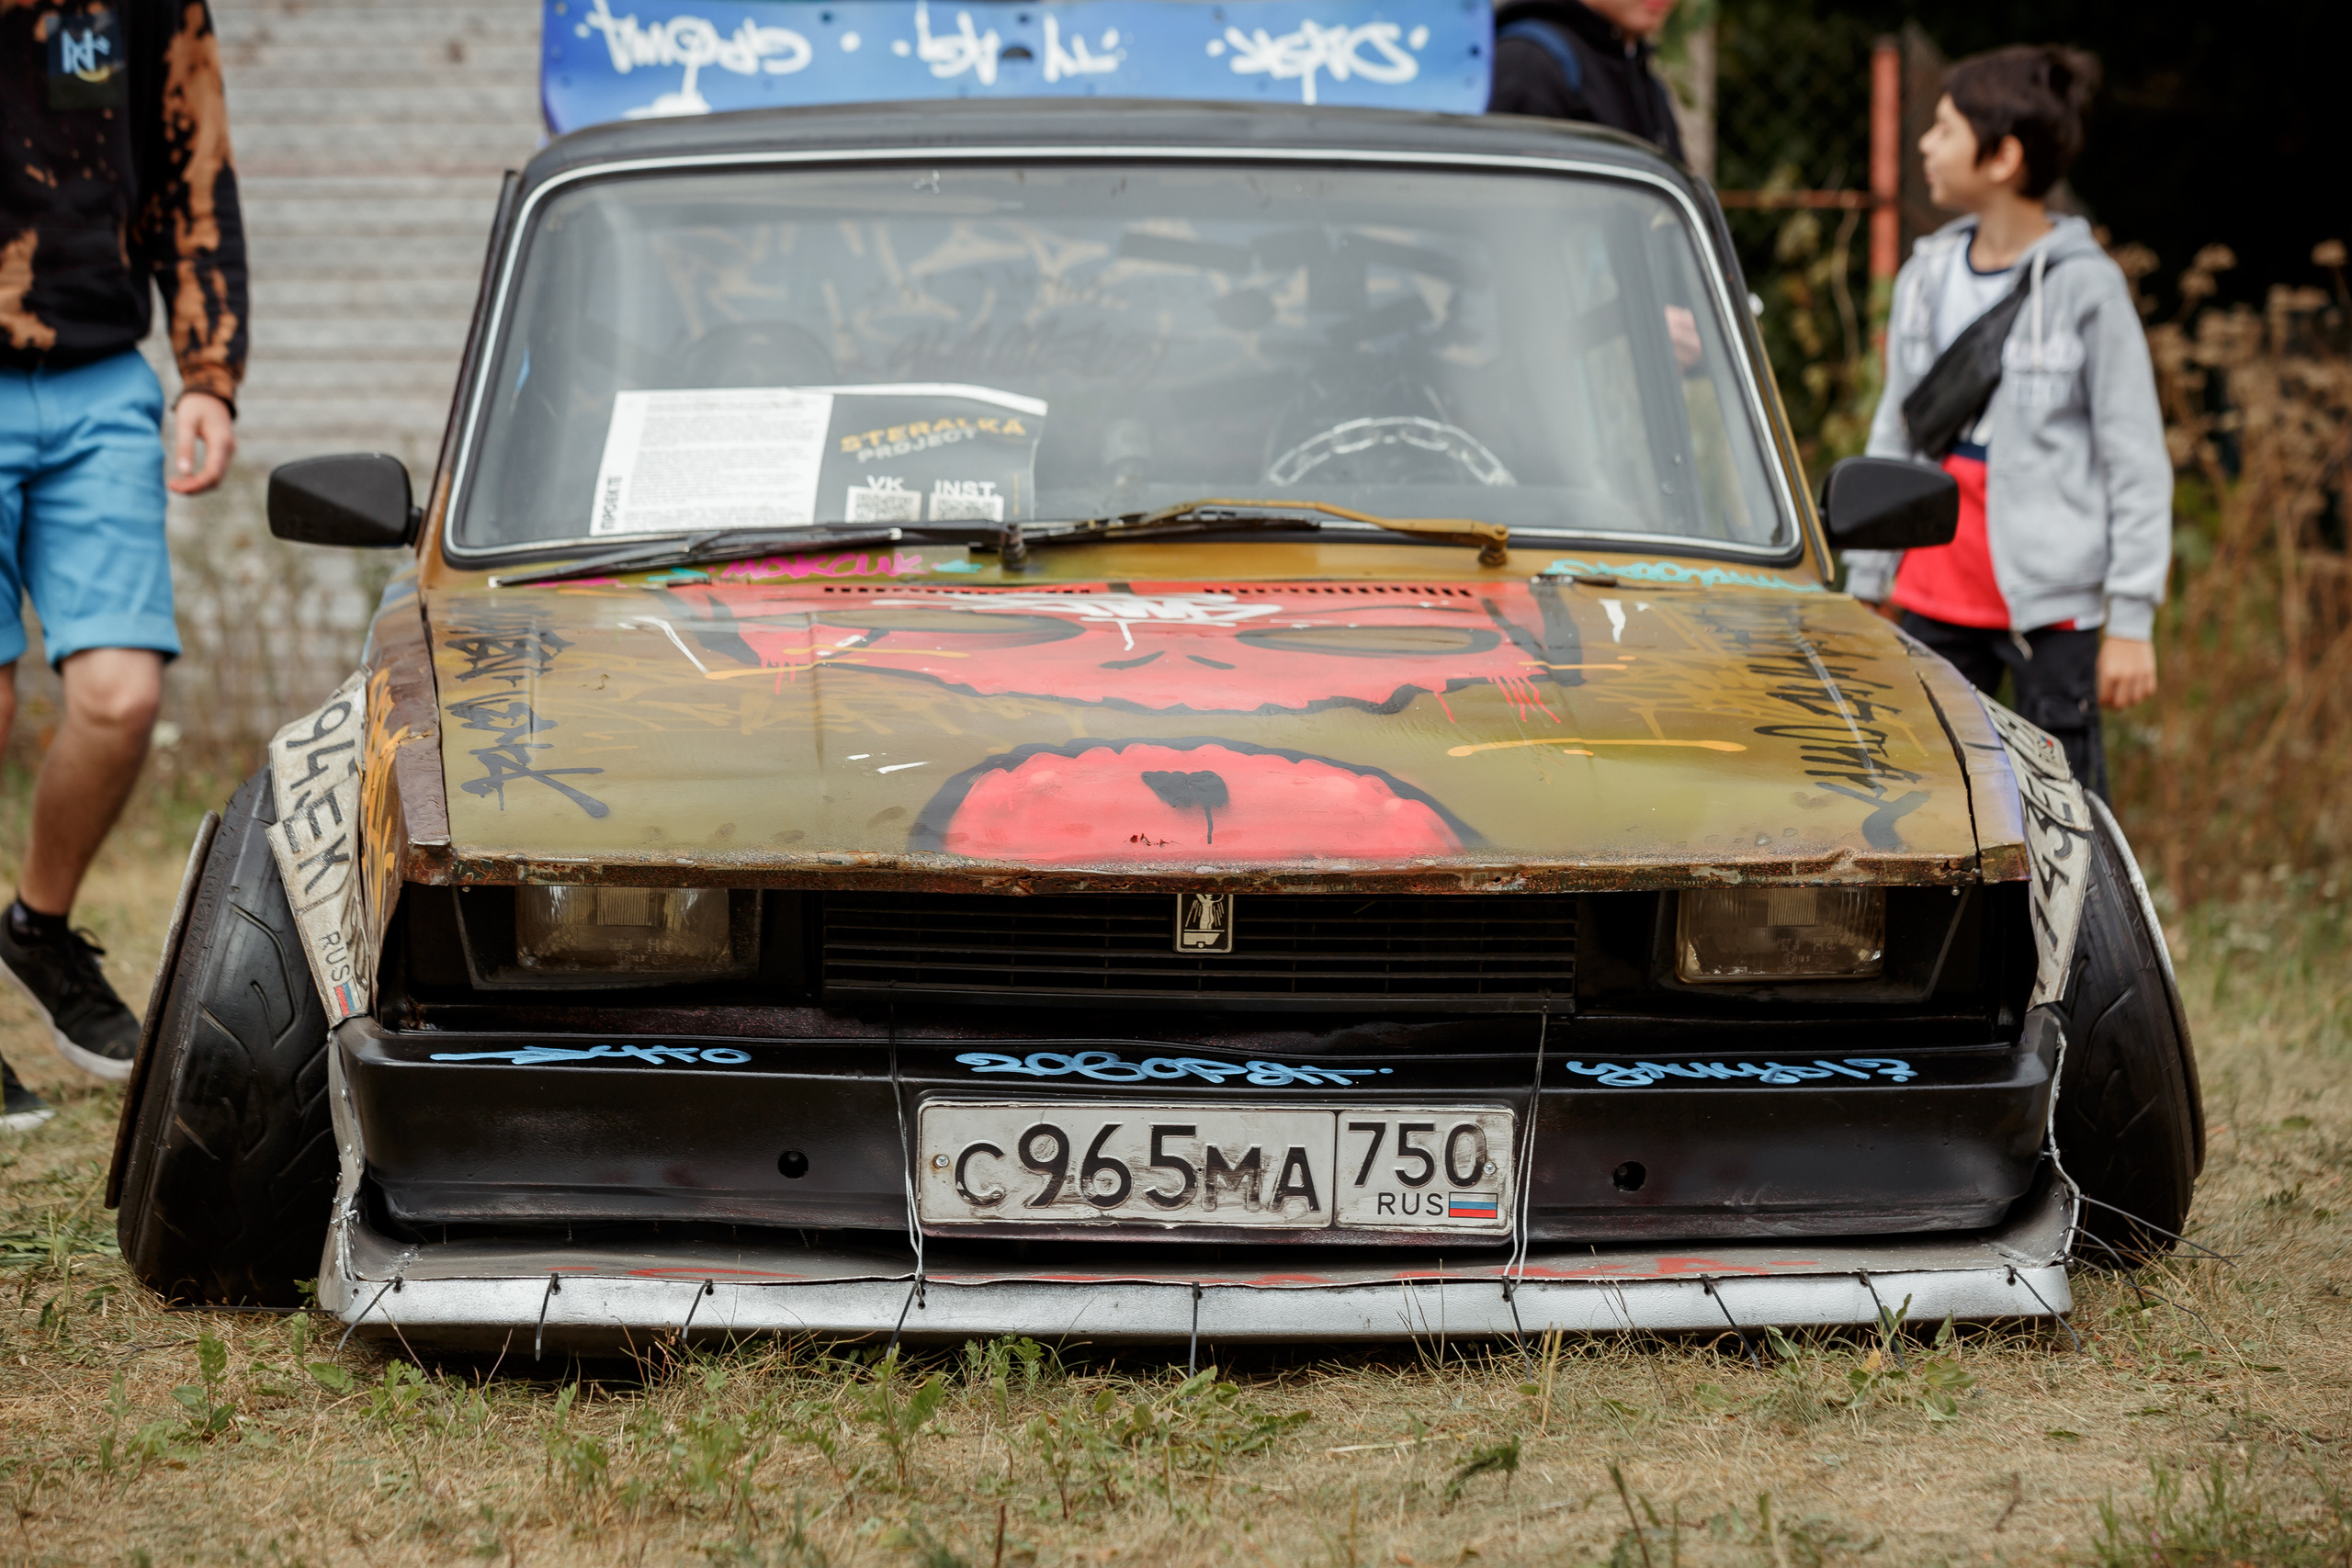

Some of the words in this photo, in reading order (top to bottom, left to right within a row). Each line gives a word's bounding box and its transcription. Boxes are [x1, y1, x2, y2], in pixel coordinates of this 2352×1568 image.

[856, 426, 978, 464] PROJECT
[865, 475, 905, 492] VK
[319, 930, 351, 983] RUS
[1346, 1120, 1489, 1190] 750
[1376, 1191, 1444, 1217] RUS
